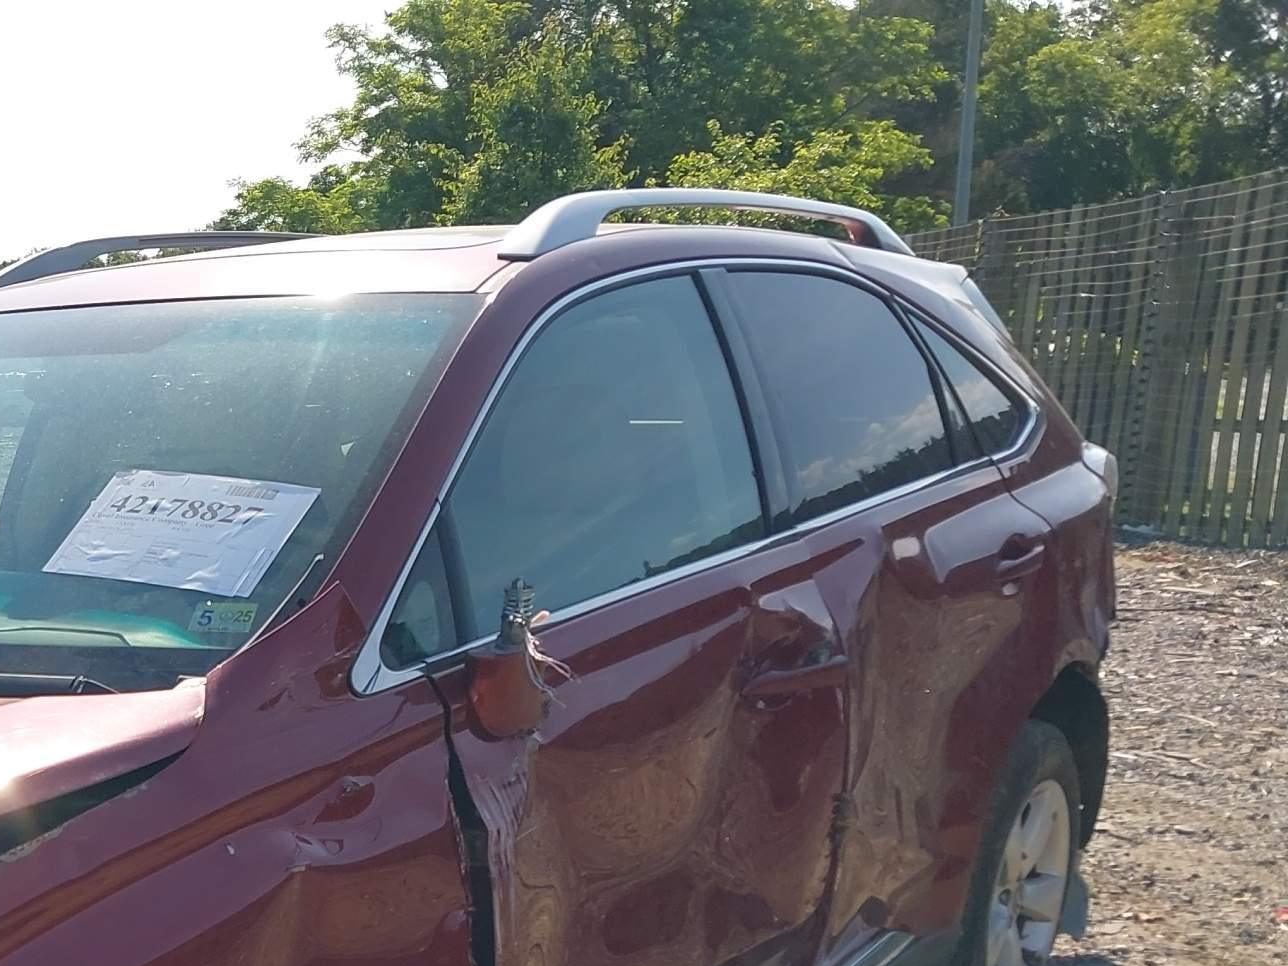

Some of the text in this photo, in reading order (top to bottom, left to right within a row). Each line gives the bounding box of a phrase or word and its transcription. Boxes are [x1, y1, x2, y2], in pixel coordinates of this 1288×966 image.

[111, 494, 264, 525] 42178827
[197, 610, 254, 627] 5 25
